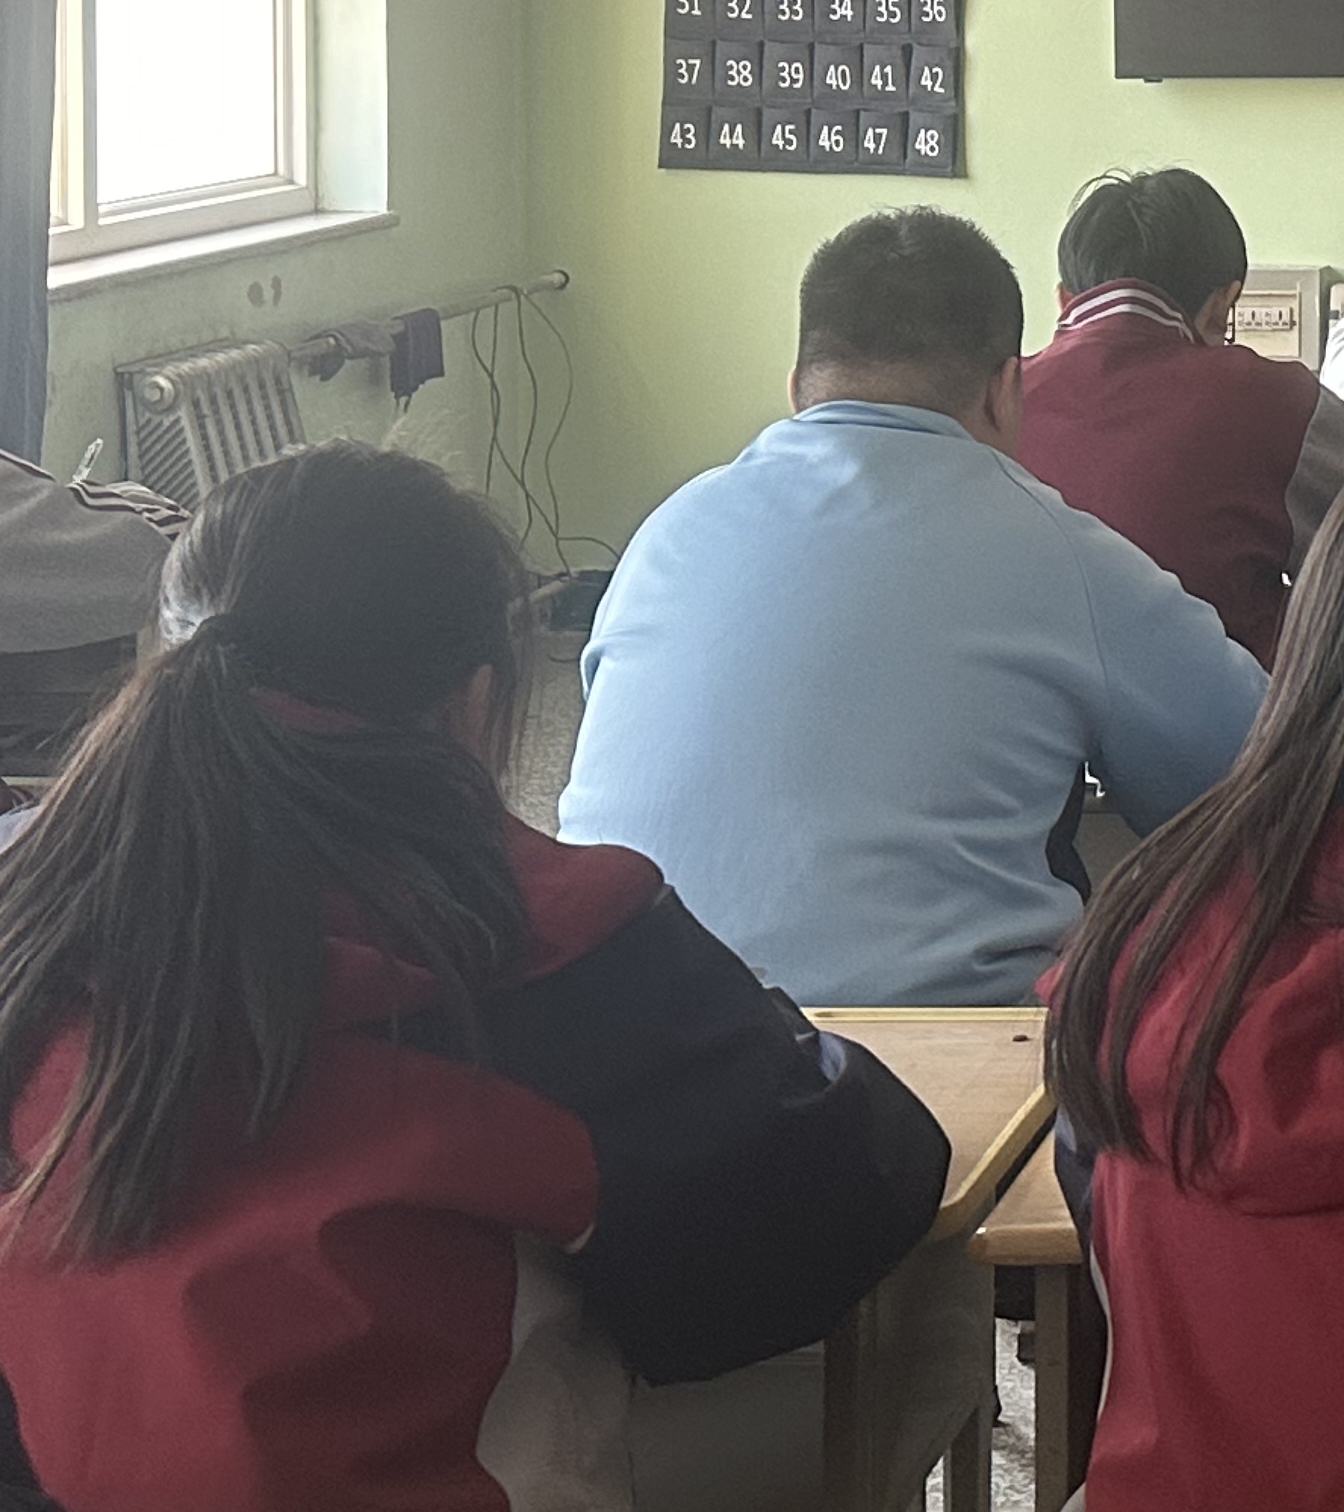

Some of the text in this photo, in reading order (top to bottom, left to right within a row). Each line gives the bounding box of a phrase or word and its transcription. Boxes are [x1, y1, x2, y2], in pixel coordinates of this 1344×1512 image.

[675, 58, 945, 94] 37 38 39 40 41 42
[670, 122, 939, 157] 43 44 45 46 47 48
